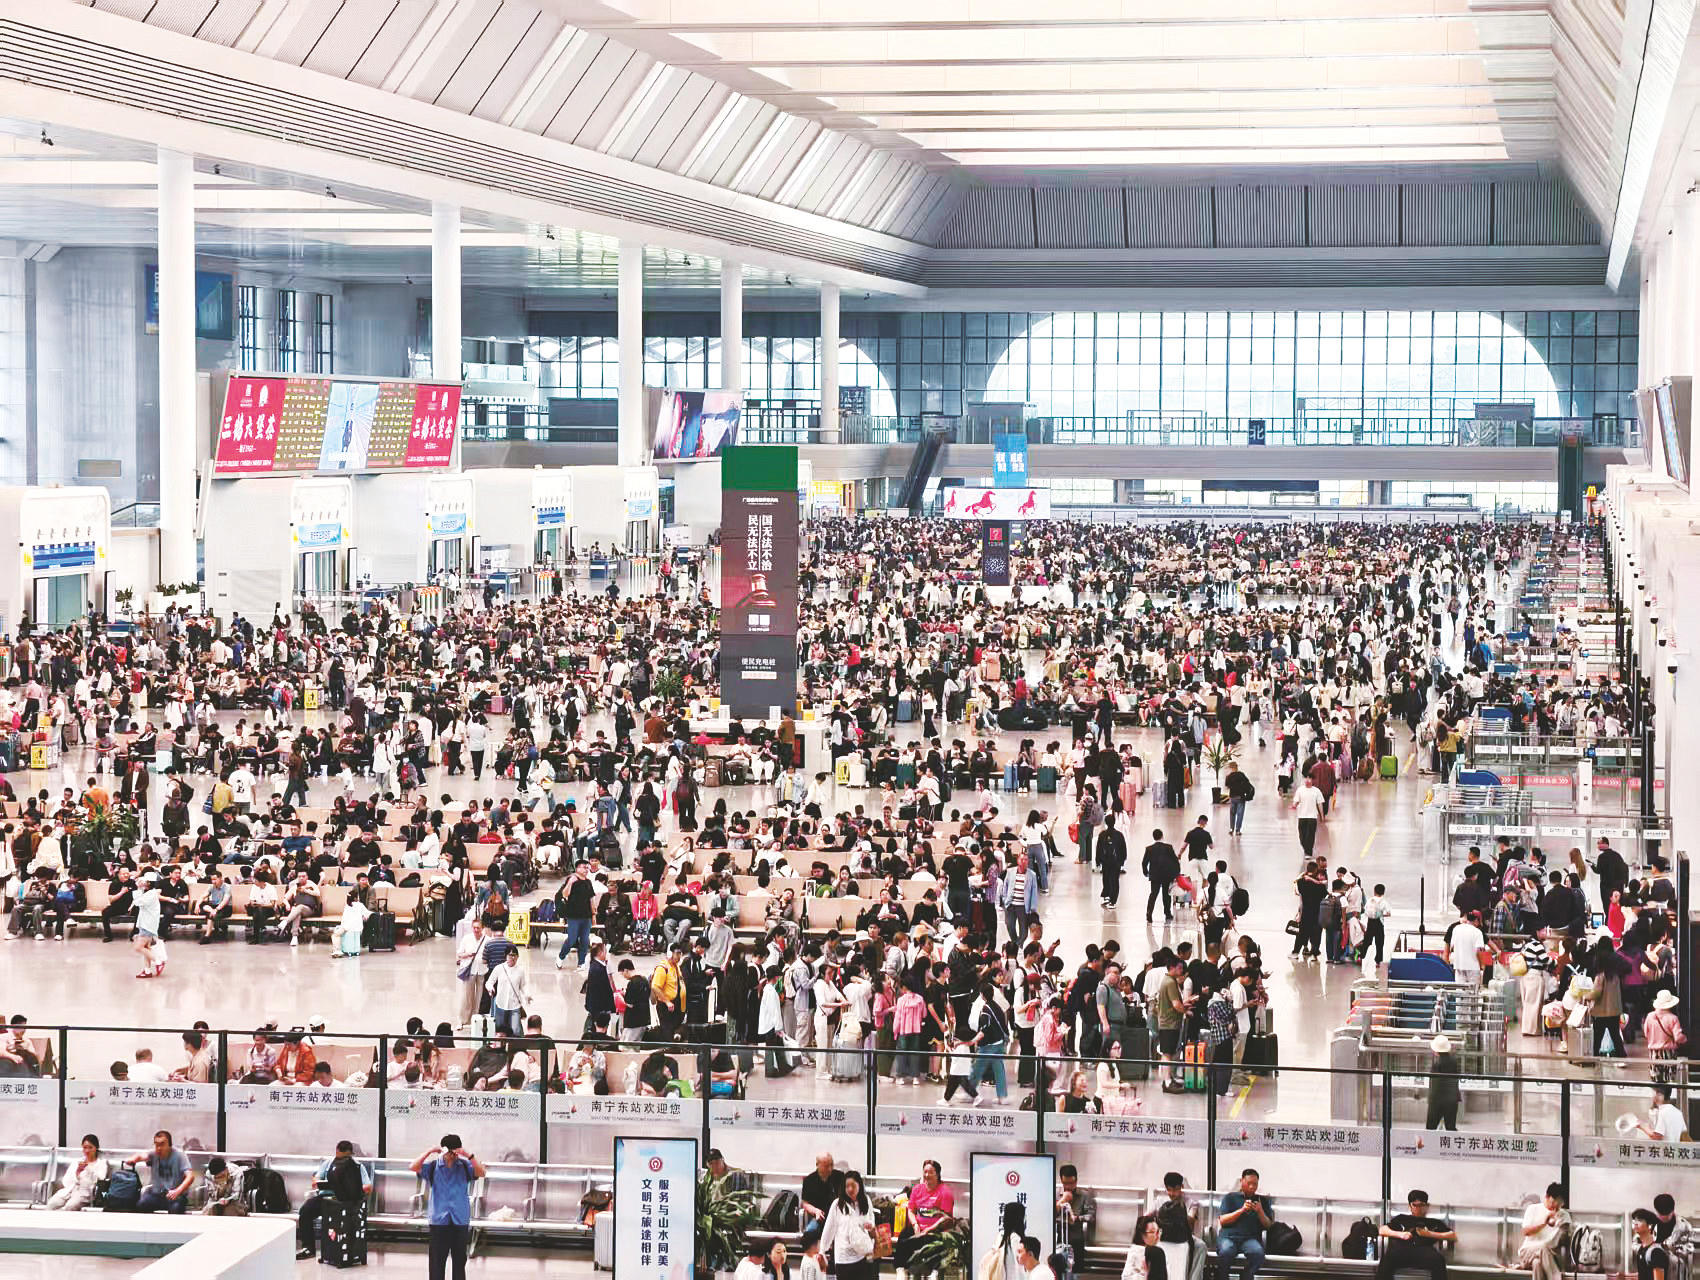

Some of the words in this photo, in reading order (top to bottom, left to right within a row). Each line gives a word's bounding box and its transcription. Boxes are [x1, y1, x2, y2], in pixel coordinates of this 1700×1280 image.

[1249, 424, 1264, 440] 北
[747, 514, 759, 571] 民无法不立
[762, 514, 773, 571] 国无法不治
[741, 657, 776, 666] 便民充电桩
[109, 1086, 197, 1100] 南宁东站欢迎您
[269, 1090, 358, 1104] 南宁东站欢迎您
[430, 1095, 519, 1110] 南宁东站欢迎您
[591, 1100, 681, 1115] 南宁东站欢迎您
[754, 1106, 846, 1121] 南宁东站欢迎您
[921, 1112, 1015, 1128] 南宁东站欢迎您
[1091, 1119, 1185, 1136] 南宁东站欢迎您
[1263, 1127, 1360, 1144] 南宁东站欢迎您
[1440, 1135, 1538, 1153] 南宁东站欢迎您
[641, 1178, 652, 1266] 文明与旅途相伴
[657, 1179, 669, 1266] 服务与山水同美
